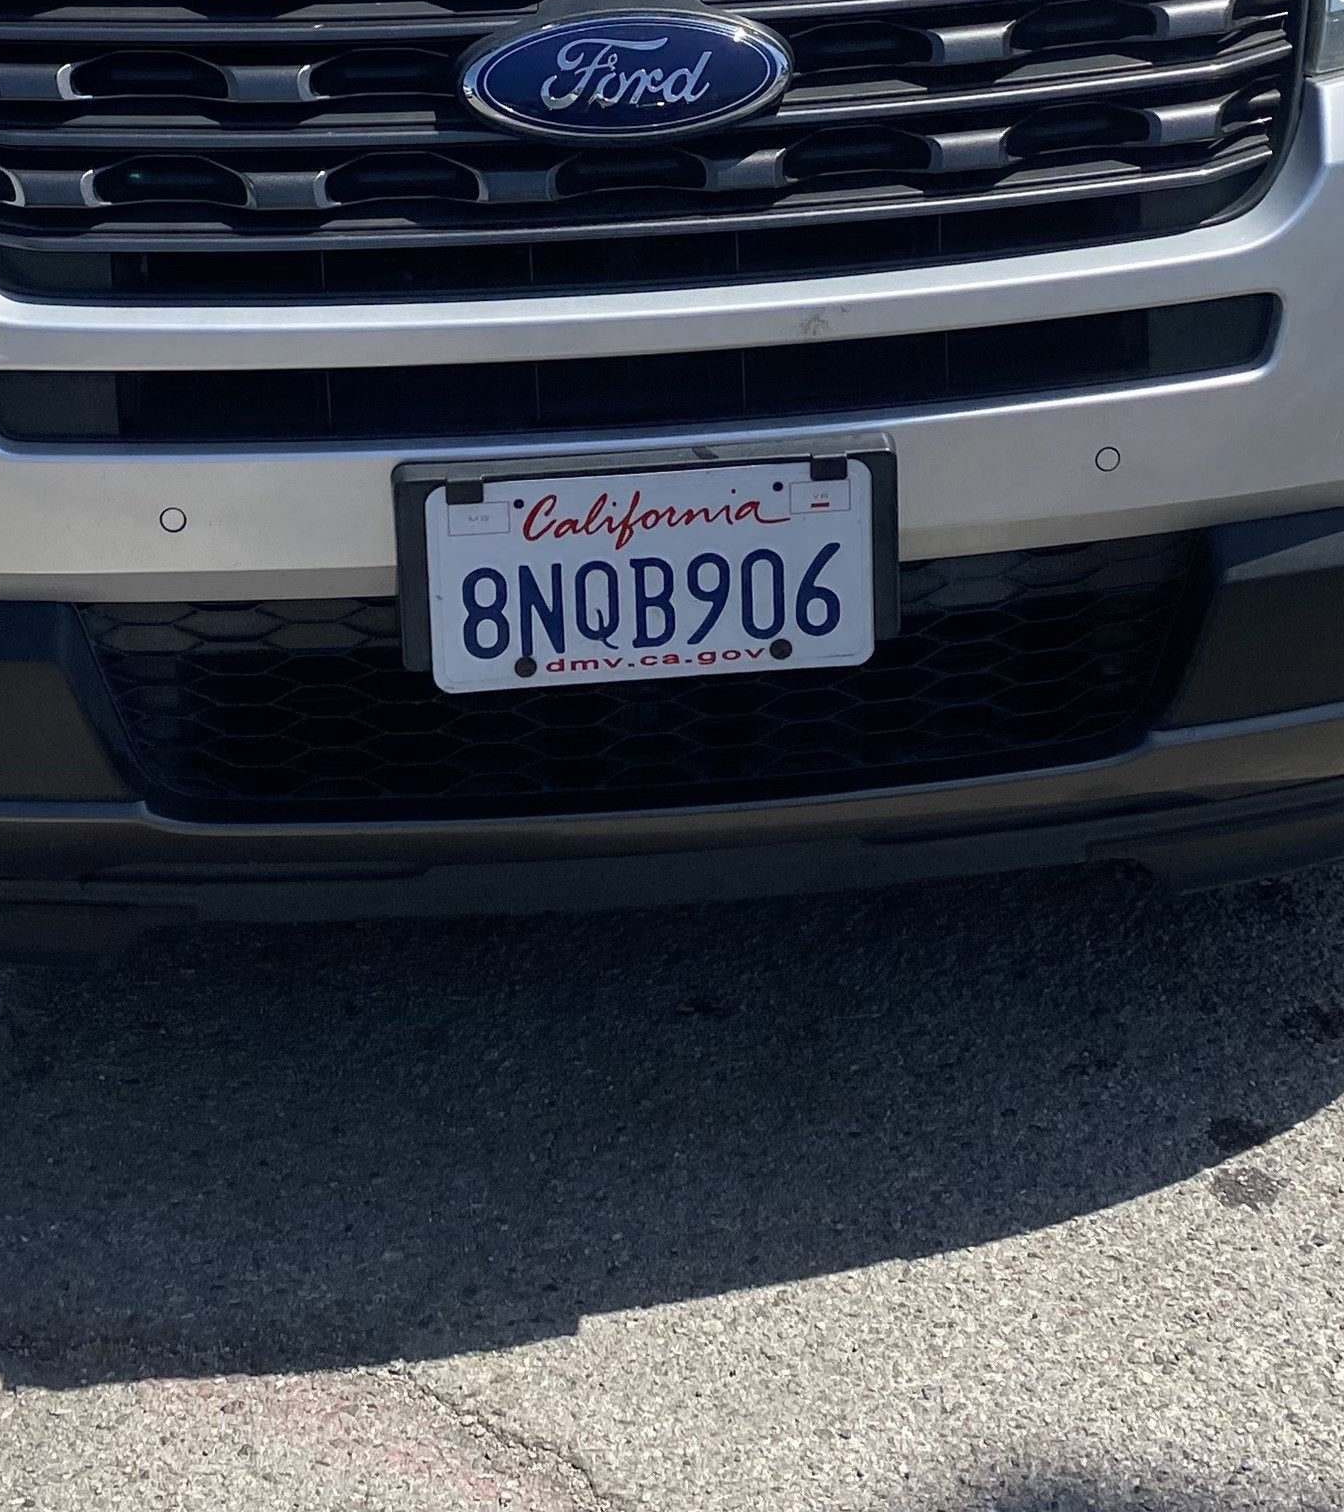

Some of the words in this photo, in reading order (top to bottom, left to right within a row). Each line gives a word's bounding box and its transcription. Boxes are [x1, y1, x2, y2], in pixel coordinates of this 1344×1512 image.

[540, 37, 711, 107] Ford
[522, 488, 792, 550] California
[462, 542, 841, 660] 8NQB906
[546, 644, 766, 674] dmv.ca.gov
